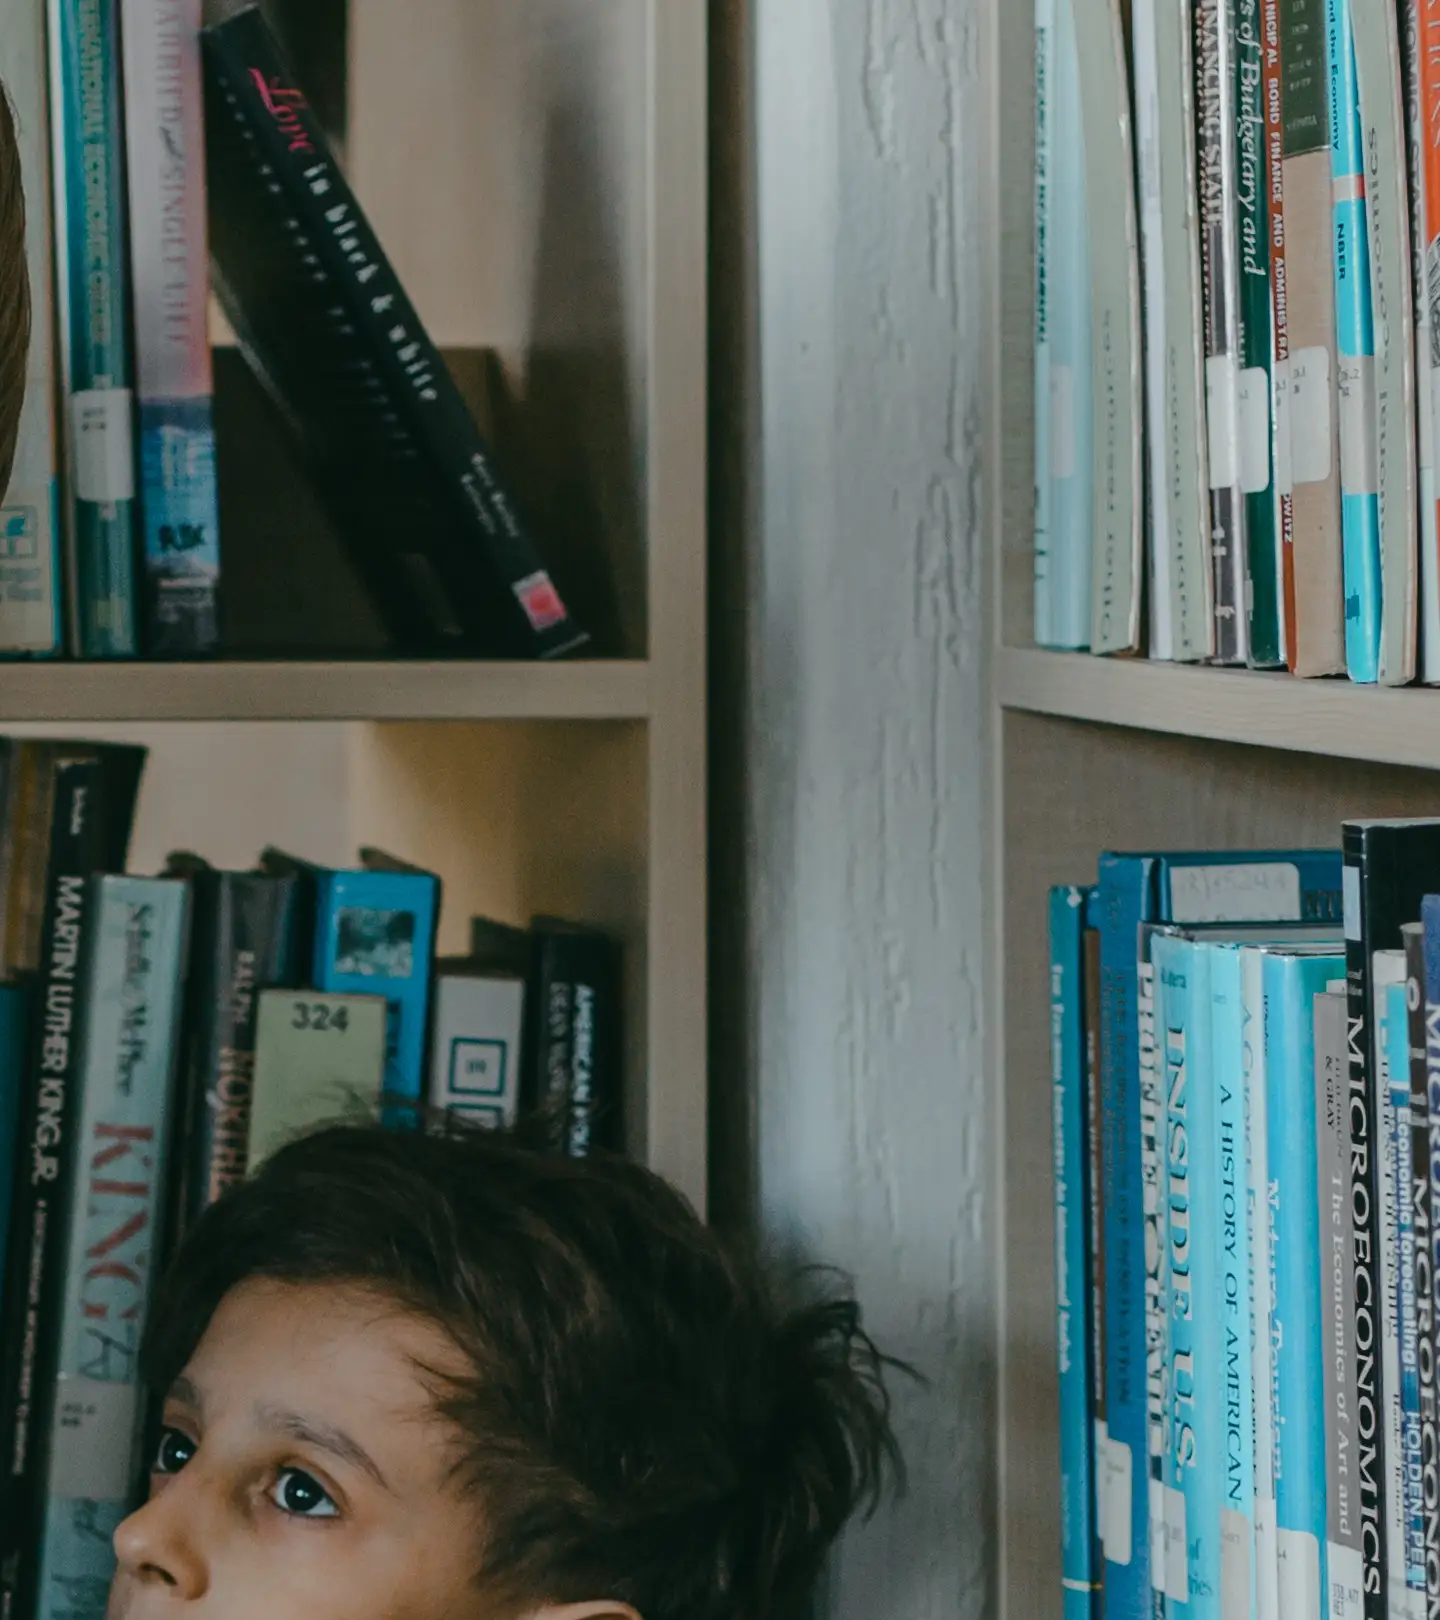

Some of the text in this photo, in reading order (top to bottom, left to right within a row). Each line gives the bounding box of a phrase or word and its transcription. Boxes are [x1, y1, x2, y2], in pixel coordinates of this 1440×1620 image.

[1236, 23, 1266, 277] of Budgetary and
[1267, 77, 1285, 248] BOND FINANCE AND
[1327, 28, 1341, 151] the Economy
[248, 69, 438, 401] Love in black white
[1336, 223, 1347, 281] NBER
[41, 875, 80, 1071] MARTIN LUTHER
[292, 1001, 350, 1036] 324
[1166, 1024, 1194, 1323] INSIDE
[1324, 1054, 1336, 1131] & GRAY
[83, 1118, 156, 1321] KING
[1220, 1083, 1242, 1502] A HISTORY OF AMERICAN
[1345, 1011, 1381, 1596] MICROECONOMICS
[1397, 1104, 1417, 1372] Economic forecasting:
[1172, 1347, 1198, 1485] U.S.
[1269, 1317, 1285, 1481] Tourism
[1330, 1171, 1352, 1535] The Economics of Art and
